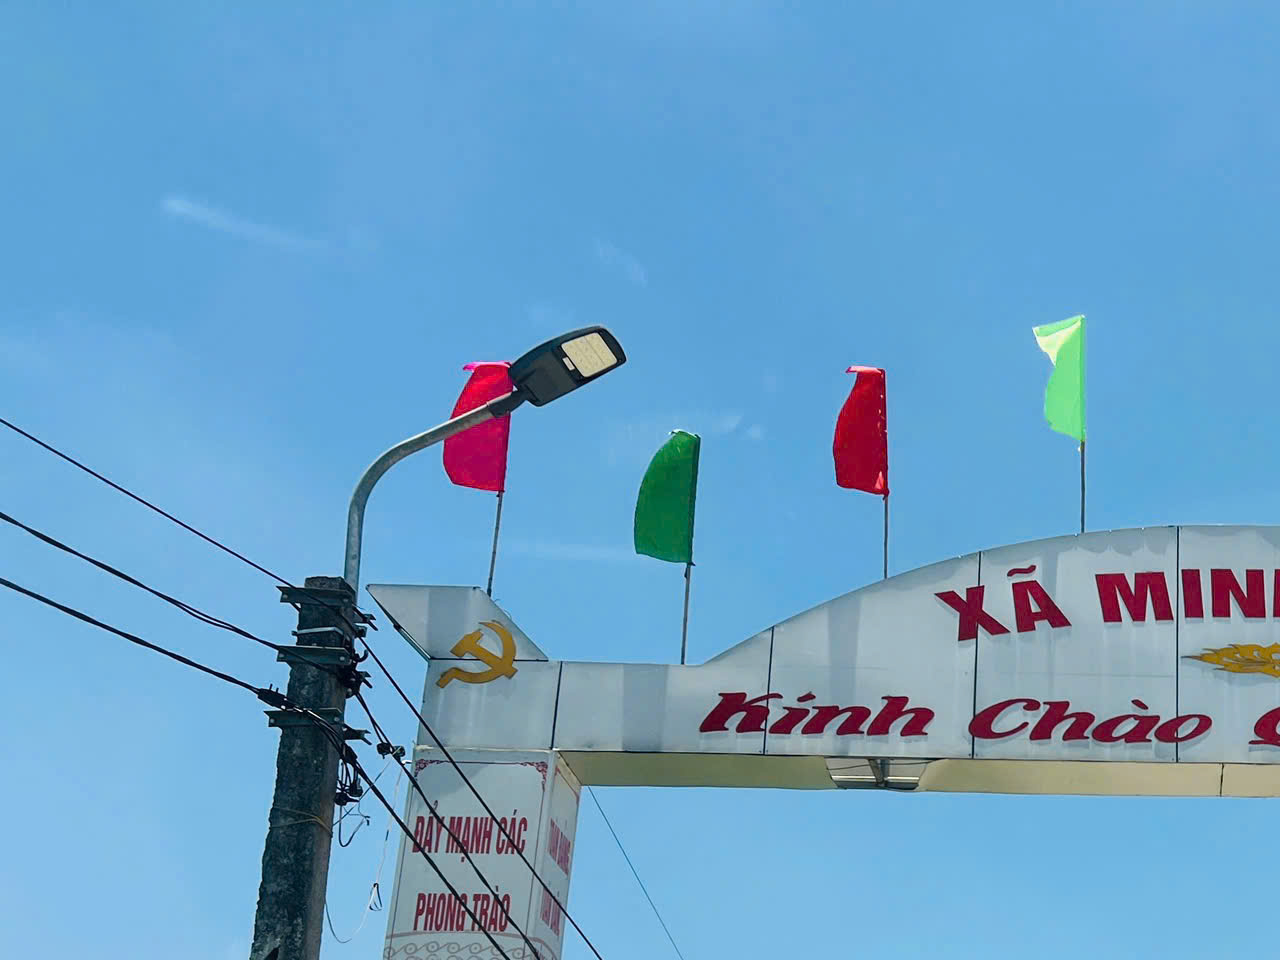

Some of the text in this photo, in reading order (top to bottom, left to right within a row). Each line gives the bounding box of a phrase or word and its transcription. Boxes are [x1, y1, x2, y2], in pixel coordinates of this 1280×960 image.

[935, 565, 1071, 641] XÃ
[699, 691, 935, 736] Kính
[968, 698, 1213, 744] Chào
[446, 817, 494, 863] MẠNH
[495, 809, 528, 853] CÁC
[414, 892, 469, 932] PHONG
[471, 885, 511, 932] TRÀO
